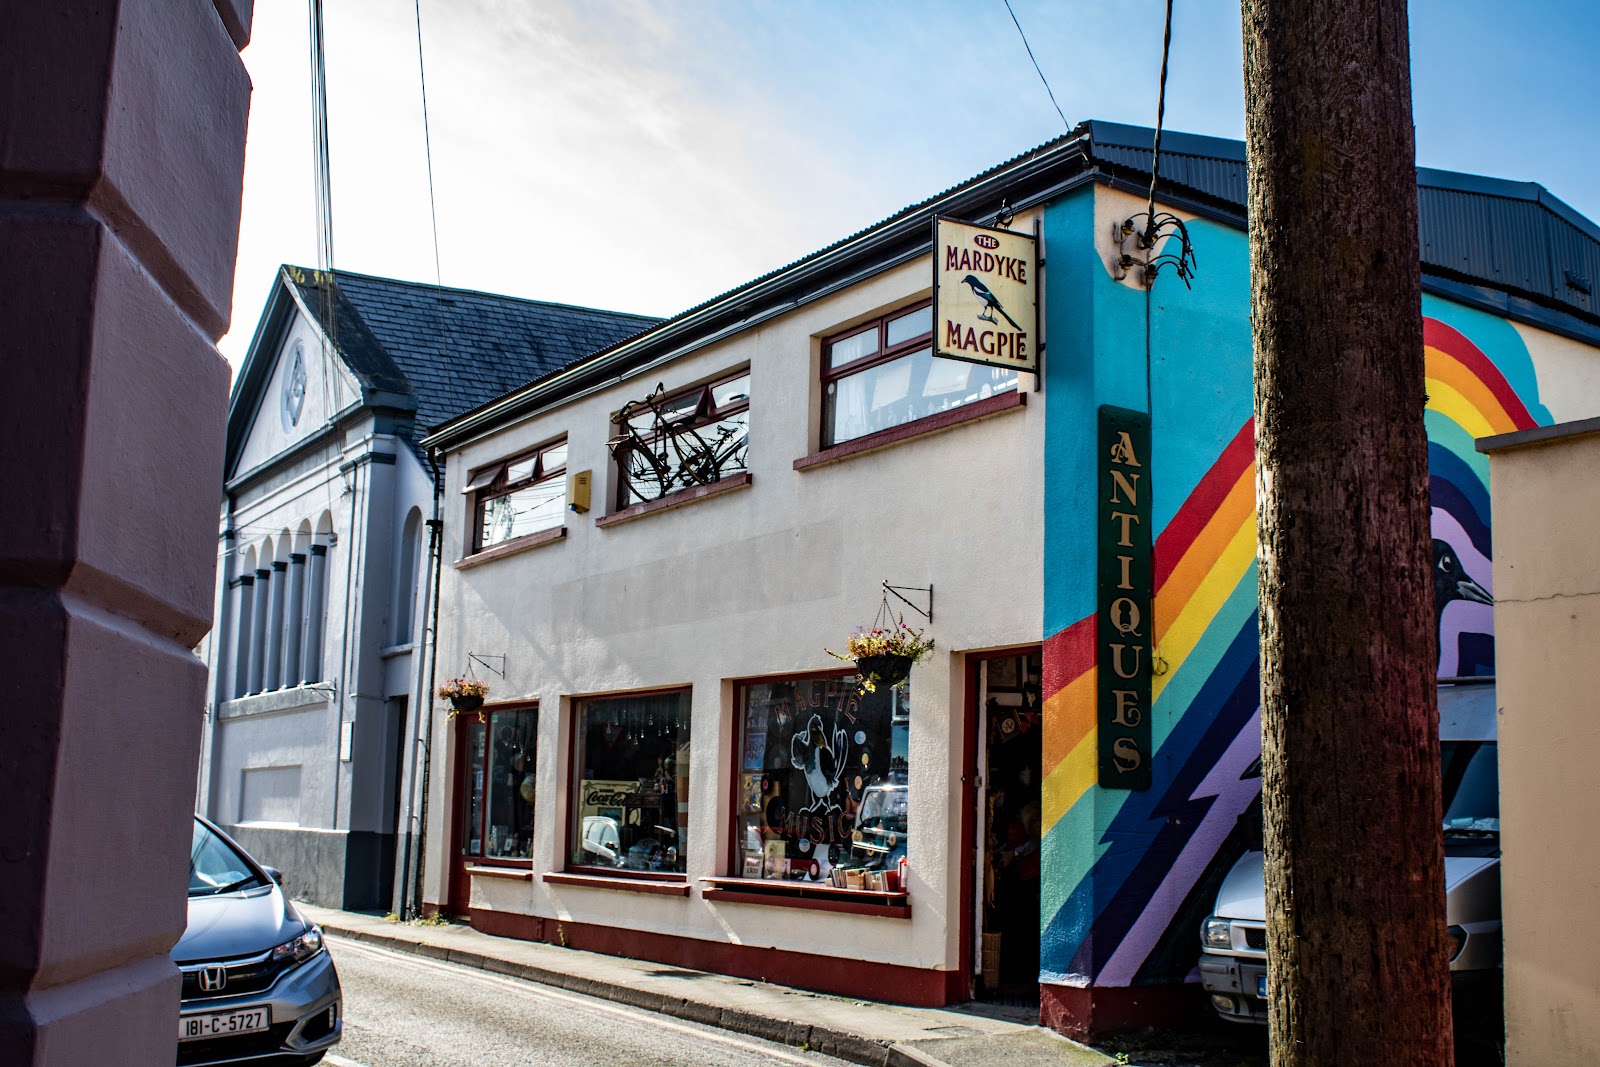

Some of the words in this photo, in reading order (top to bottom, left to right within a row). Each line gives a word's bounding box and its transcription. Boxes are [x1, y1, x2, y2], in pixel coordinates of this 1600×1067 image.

[976, 235, 997, 249] THE
[945, 245, 1027, 285] MARDYKE
[945, 320, 1027, 361] MAGPIE
[1109, 431, 1142, 775] ANTIQUES
[775, 679, 864, 732] MAGPIE
[778, 806, 853, 845] MUSIC
[186, 1012, 262, 1036] 181-C-5727
